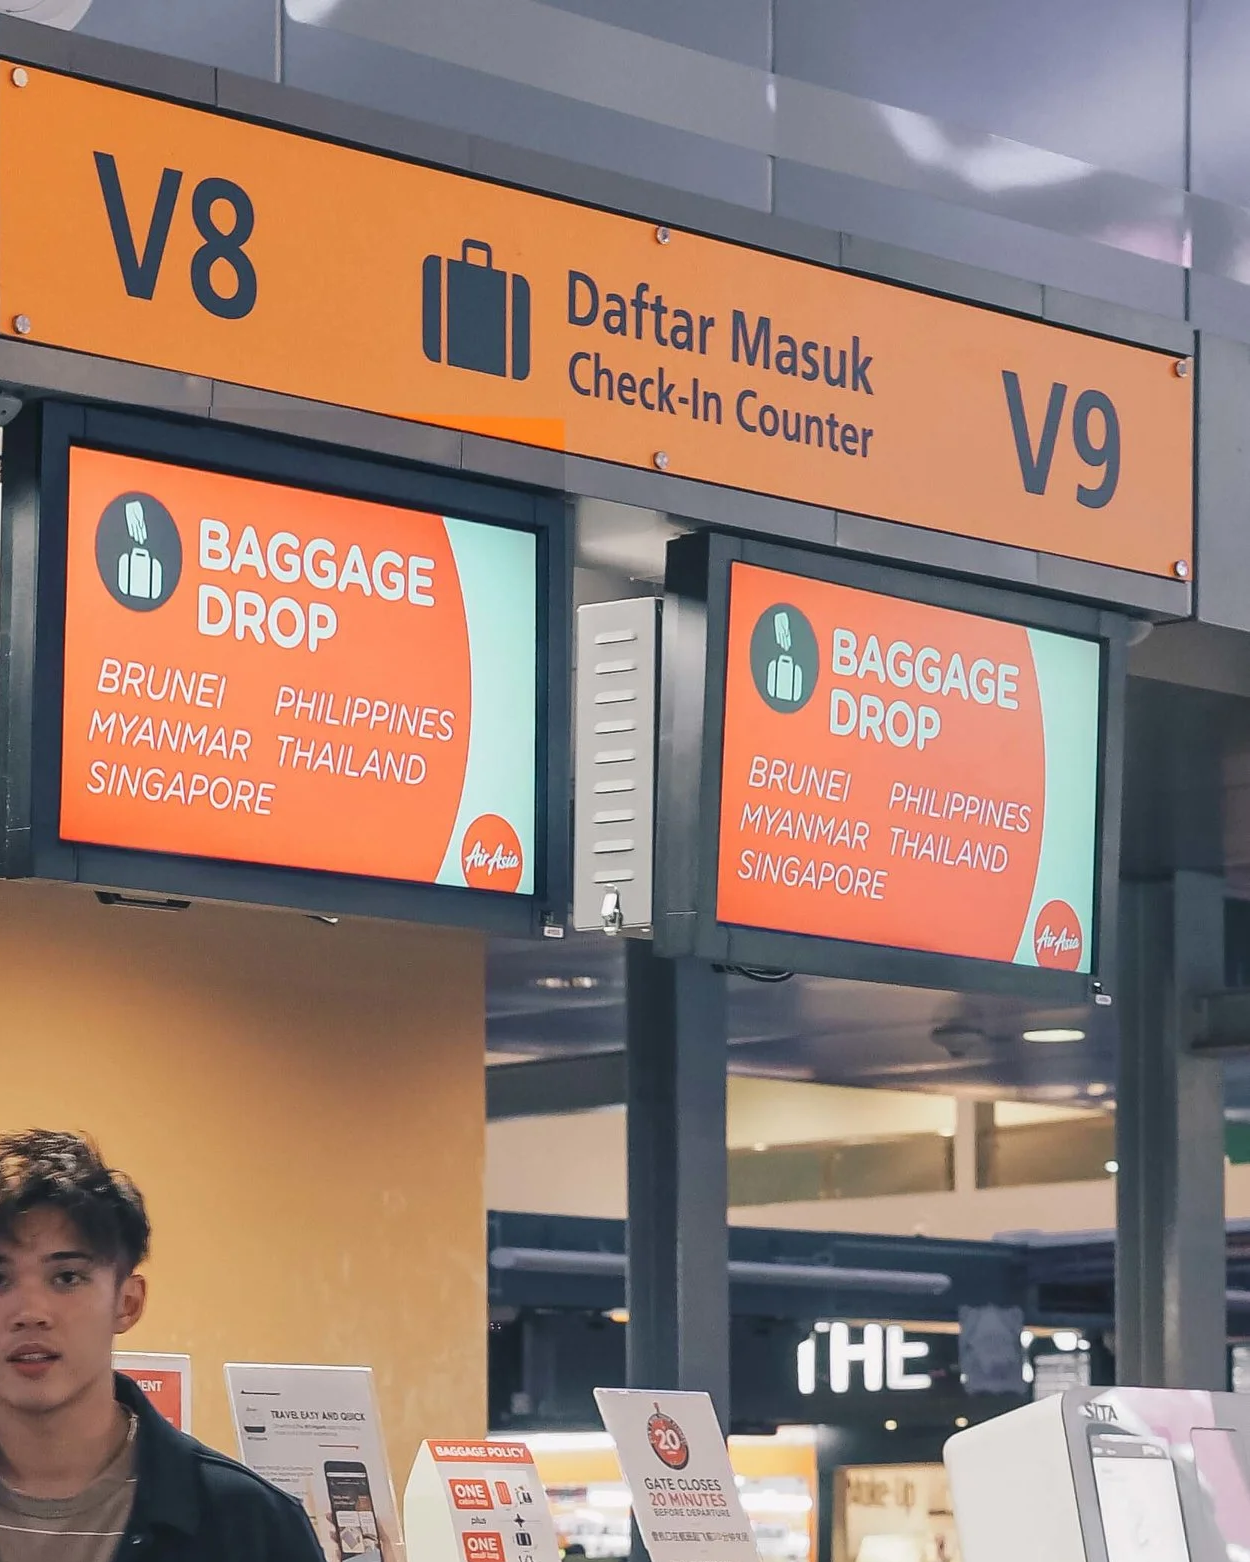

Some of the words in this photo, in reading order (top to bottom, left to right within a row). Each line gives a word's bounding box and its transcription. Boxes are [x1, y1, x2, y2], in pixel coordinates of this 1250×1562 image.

[92, 152, 259, 320] V8
[567, 269, 716, 352] Daftar
[730, 313, 875, 396] Masuk
[568, 351, 724, 426] Check-In
[735, 390, 875, 460] Counter
[1001, 369, 1123, 509] V9
[198, 518, 435, 607] BAGGAGE
[197, 584, 338, 652] DROP
[97, 658, 227, 709] BRUNEI
[831, 628, 1020, 710] BAGGAGE
[88, 711, 251, 761] MYANMAR
[275, 686, 456, 742] PHILIPPINES
[829, 690, 941, 751] DROP
[278, 737, 427, 785] THAILAND
[748, 756, 851, 802] BRUNEI
[86, 761, 275, 815] SINGAPORE
[888, 782, 1031, 832] PHILIPPINES
[739, 804, 870, 851] MYANMAR
[888, 827, 1009, 873] THAILAND
[737, 851, 888, 900] SINGAPORE
[797, 1321, 931, 1394] THE
[137, 1380, 163, 1392] ENT
[270, 1410, 299, 1419] TRAVEL
[300, 1411, 319, 1420] EASY
[322, 1411, 338, 1421] AND
[340, 1412, 366, 1421] QUICK
[1084, 1402, 1118, 1421] SITA
[435, 1446, 487, 1457] BAGGAGE
[487, 1446, 524, 1457] POLICY
[654, 1429, 681, 1450] 20
[453, 1484, 486, 1498] ONE
[644, 1477, 675, 1490] GATE
[677, 1478, 721, 1491] CLOSES
[649, 1492, 666, 1506] 20
[668, 1492, 727, 1507] MINUTES
[653, 1508, 685, 1517] BEFORE
[686, 1508, 731, 1517] DEPARTURE
[467, 1537, 498, 1551] ONE
